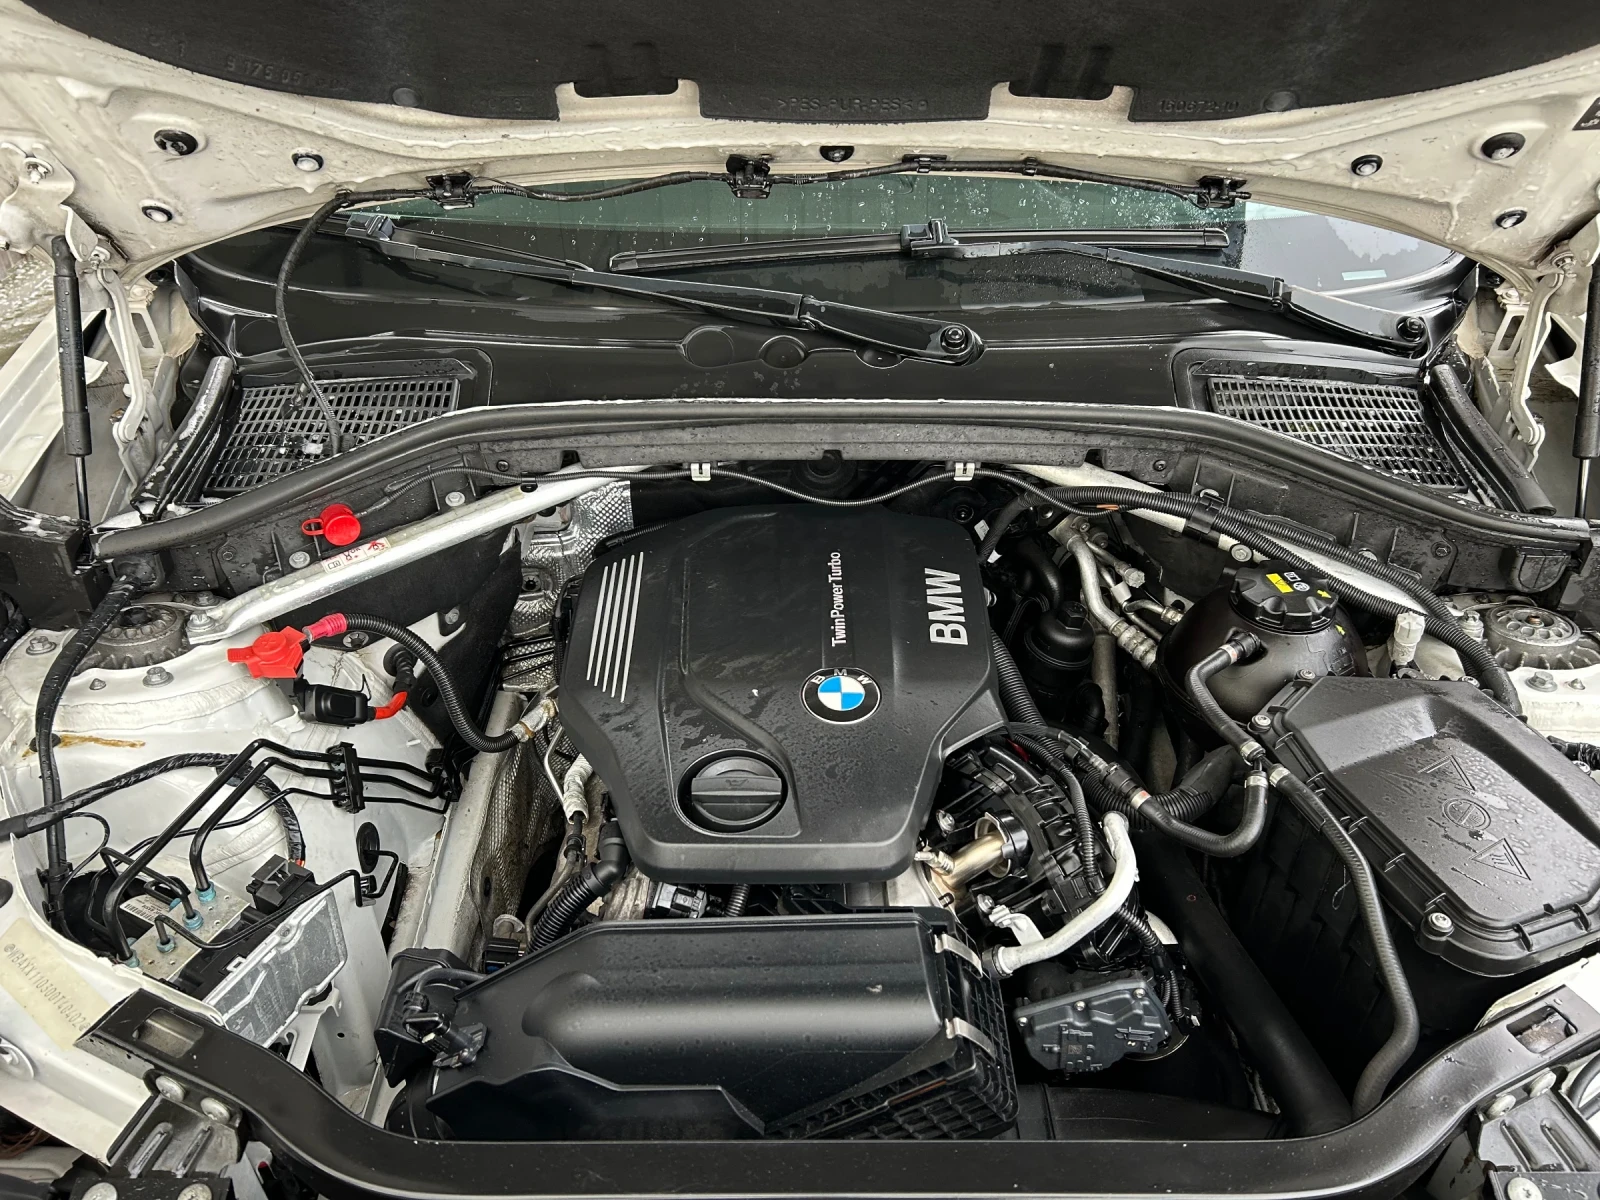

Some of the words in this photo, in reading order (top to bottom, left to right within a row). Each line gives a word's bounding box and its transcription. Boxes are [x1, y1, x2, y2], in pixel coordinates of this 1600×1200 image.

[827, 551, 843, 583] Turbo
[924, 567, 969, 646] BMW
[810, 668, 873, 685] BMW
